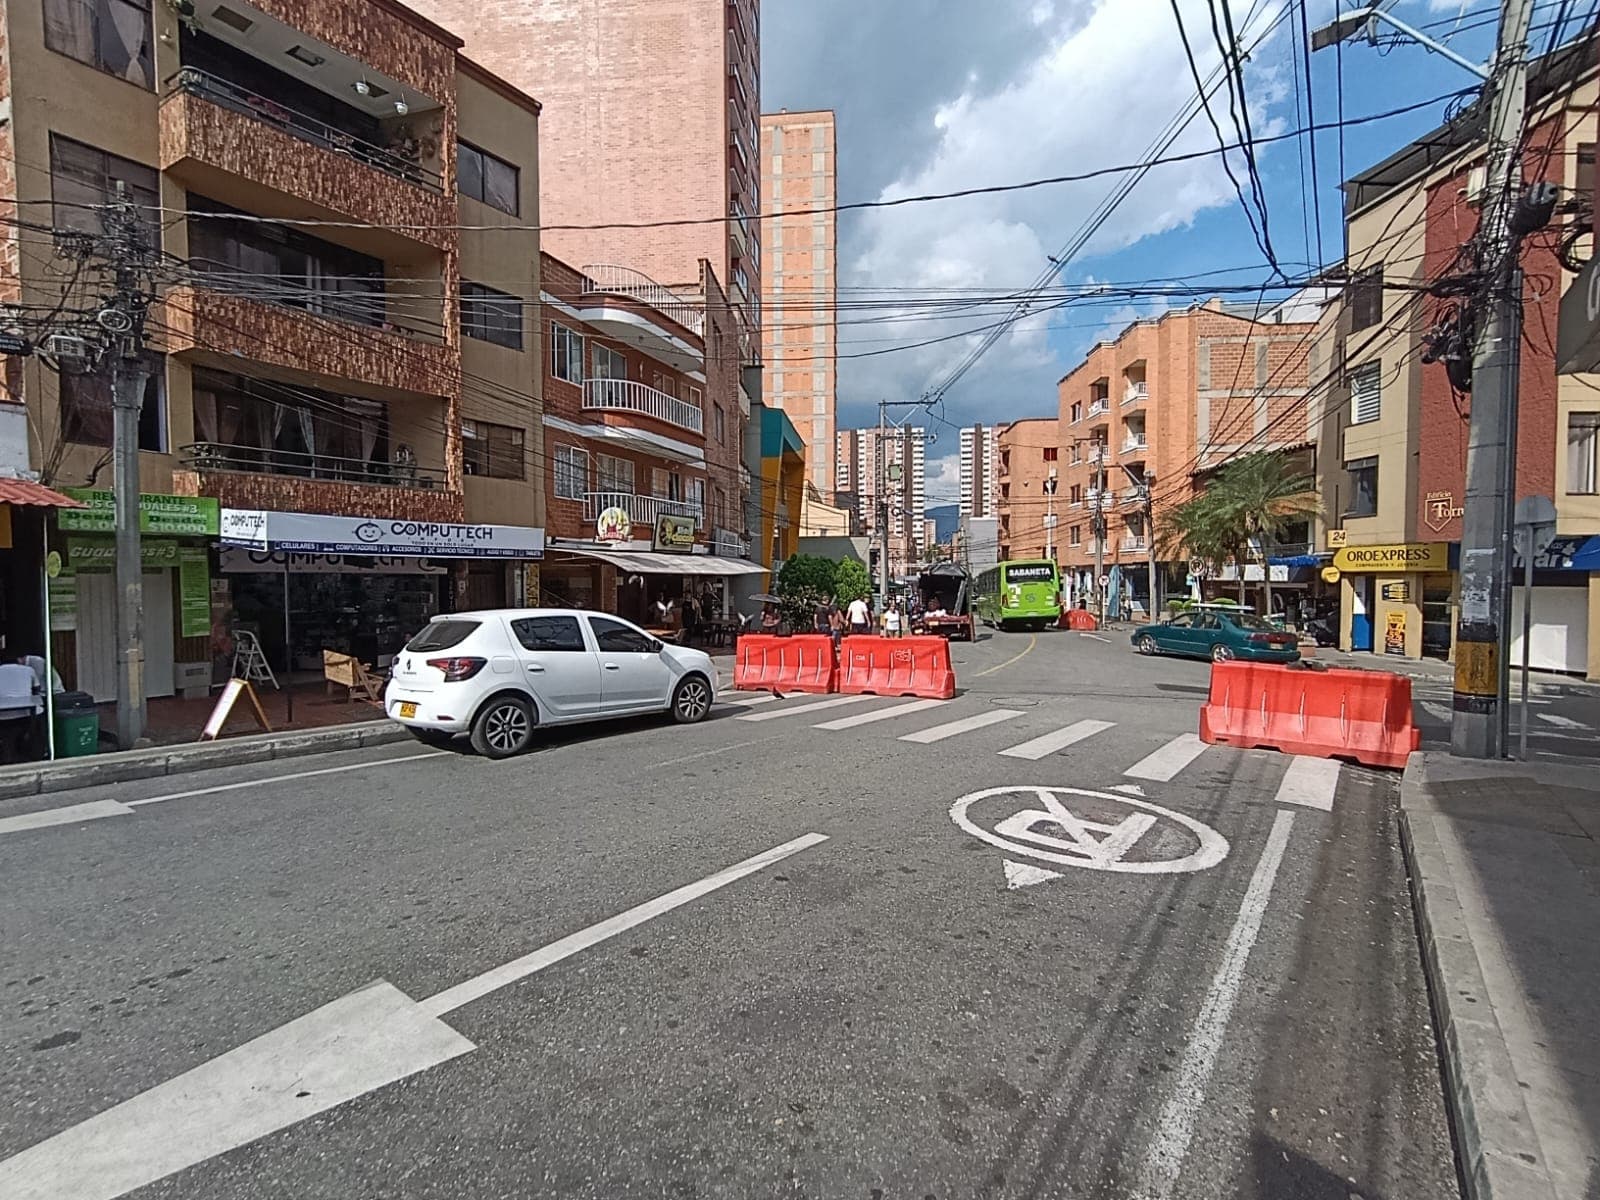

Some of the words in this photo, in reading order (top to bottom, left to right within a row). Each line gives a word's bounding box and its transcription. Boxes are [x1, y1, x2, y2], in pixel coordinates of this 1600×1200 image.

[390, 522, 493, 540] COMPUTECH
[1332, 531, 1346, 541] 24
[281, 542, 316, 550] CELULARES
[1346, 548, 1431, 562] OROEXPRESS
[1008, 567, 1052, 577] SABANETA
